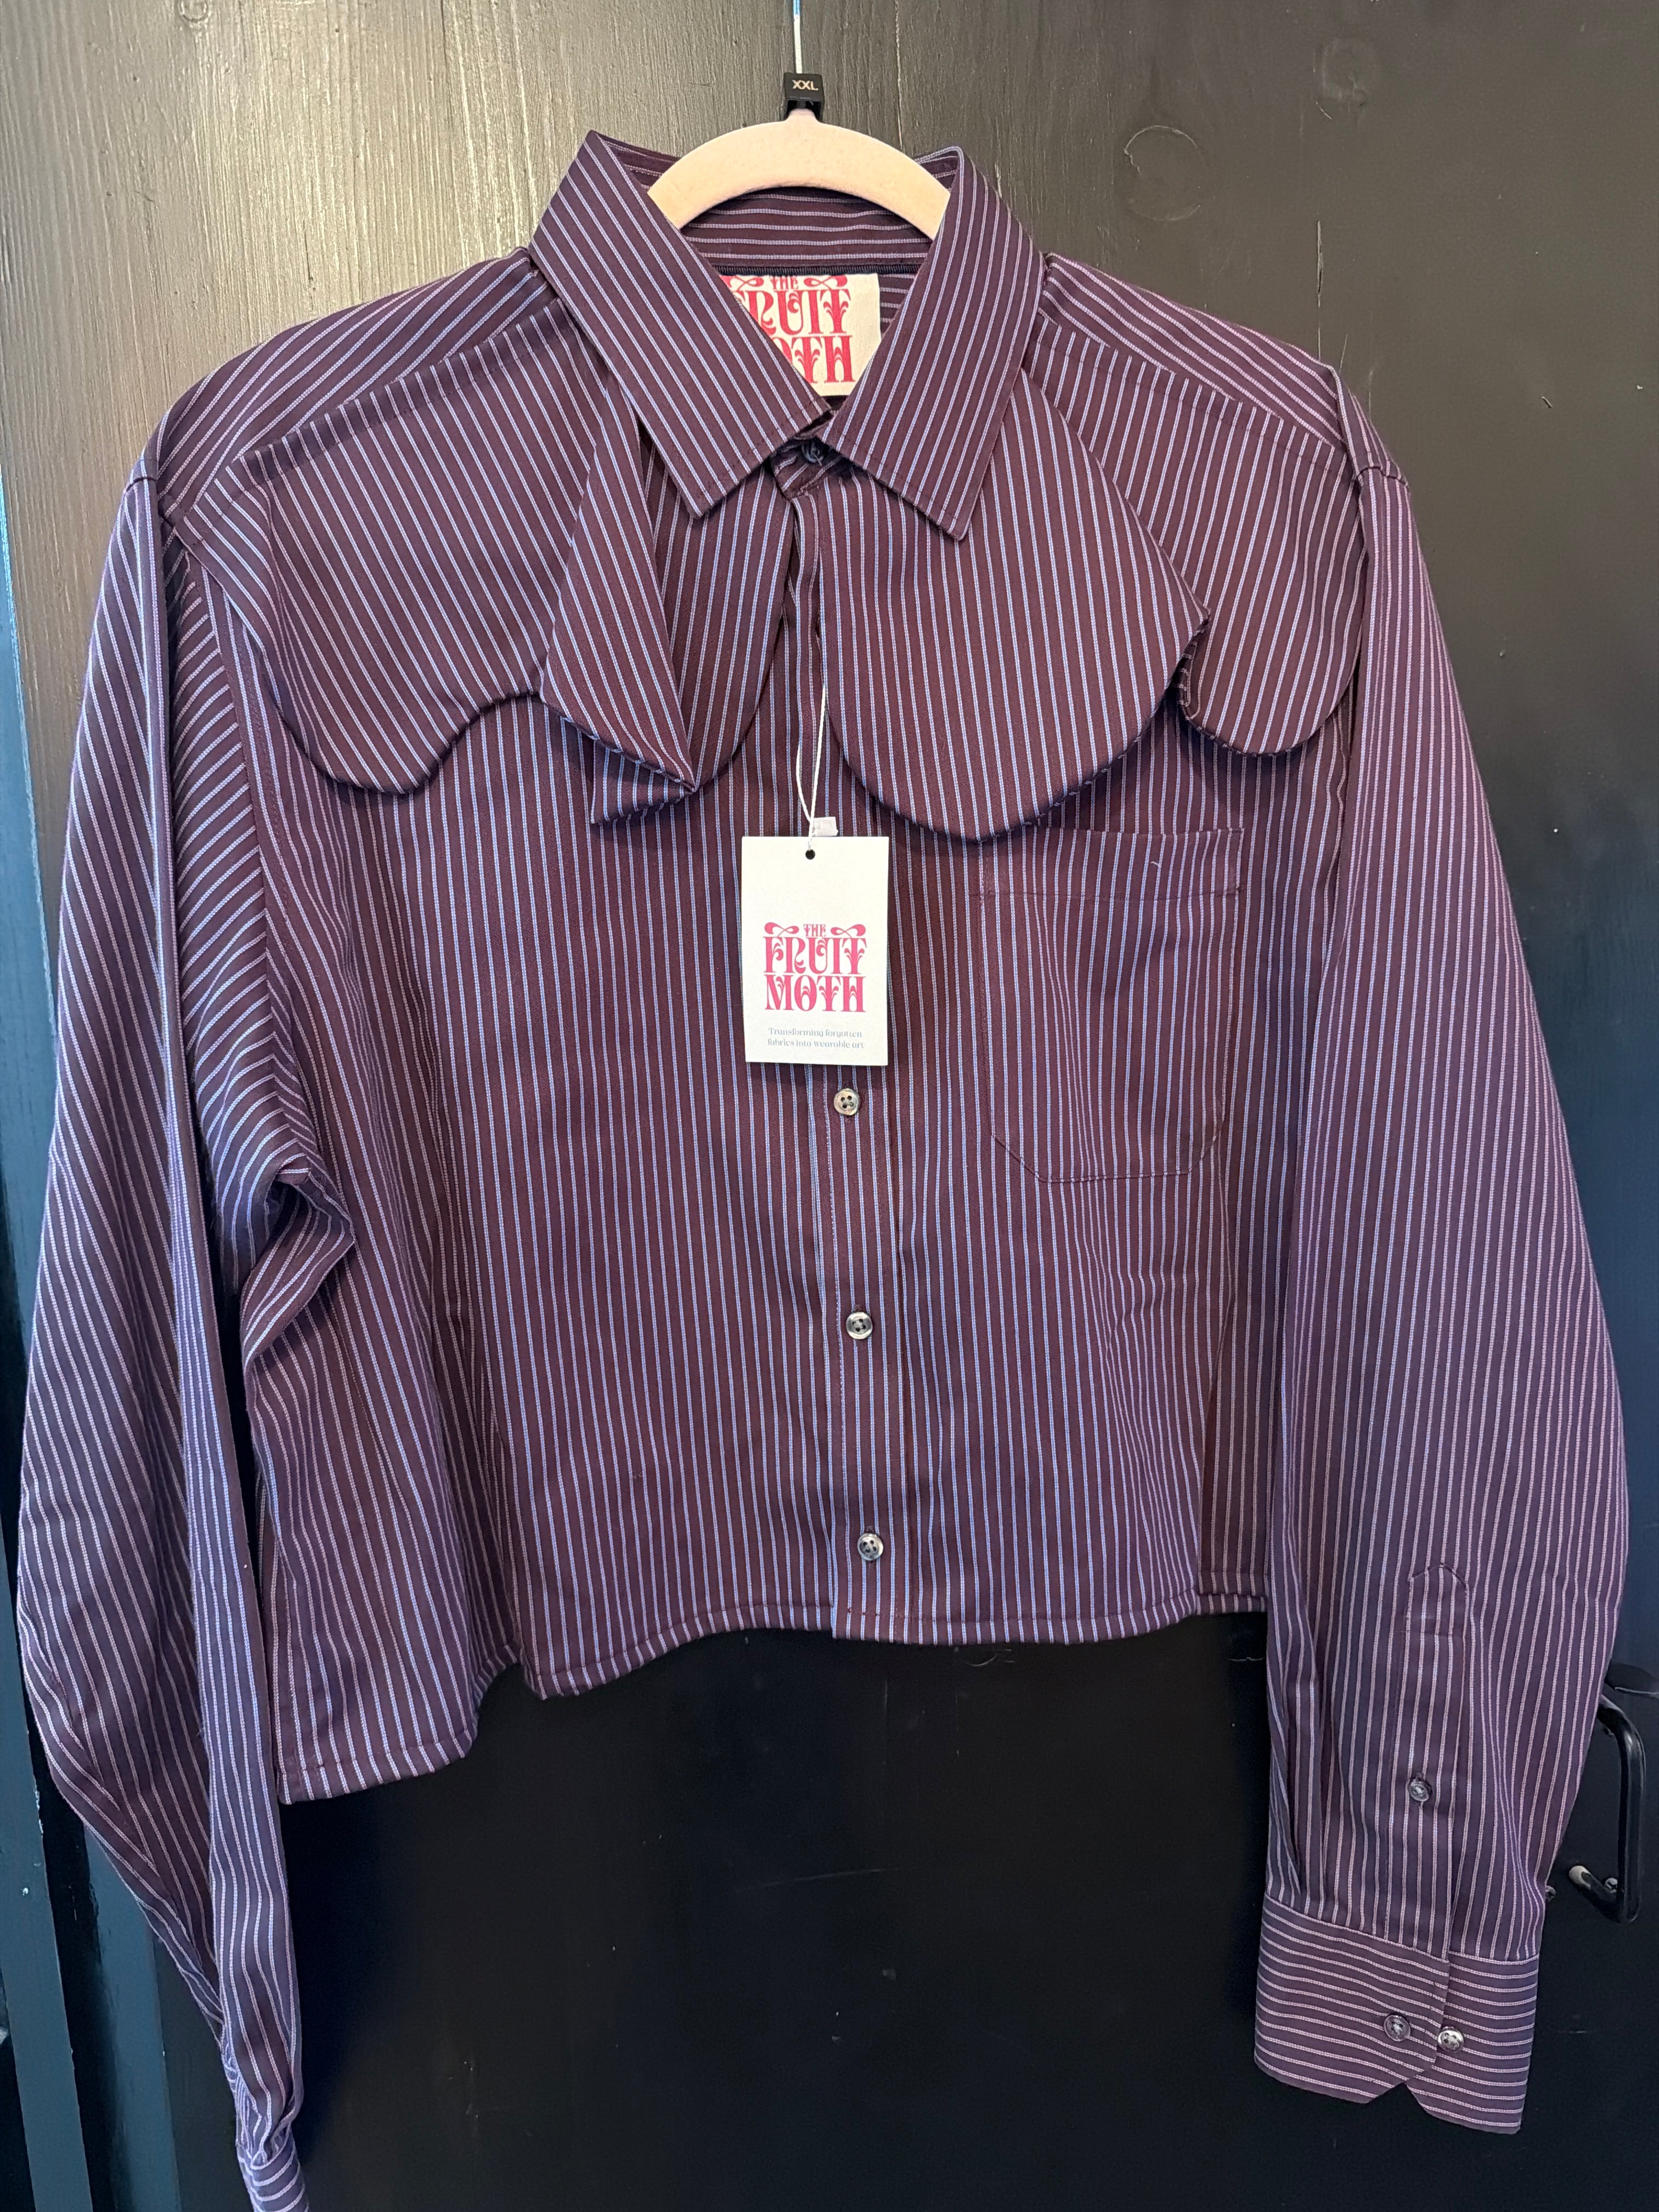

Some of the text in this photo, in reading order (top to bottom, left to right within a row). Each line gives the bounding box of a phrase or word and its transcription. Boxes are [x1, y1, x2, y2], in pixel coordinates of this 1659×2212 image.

[792, 80, 819, 91] XXL
[769, 275, 799, 290] THE
[732, 289, 851, 336] RUIT
[803, 923, 827, 937] THE
[763, 936, 867, 975] FRUIT
[763, 974, 867, 1013] MOTH
[768, 1027, 862, 1038] Transforming forgotten
[768, 1038, 794, 1046] fabrics
[813, 1040, 850, 1048] wearable
